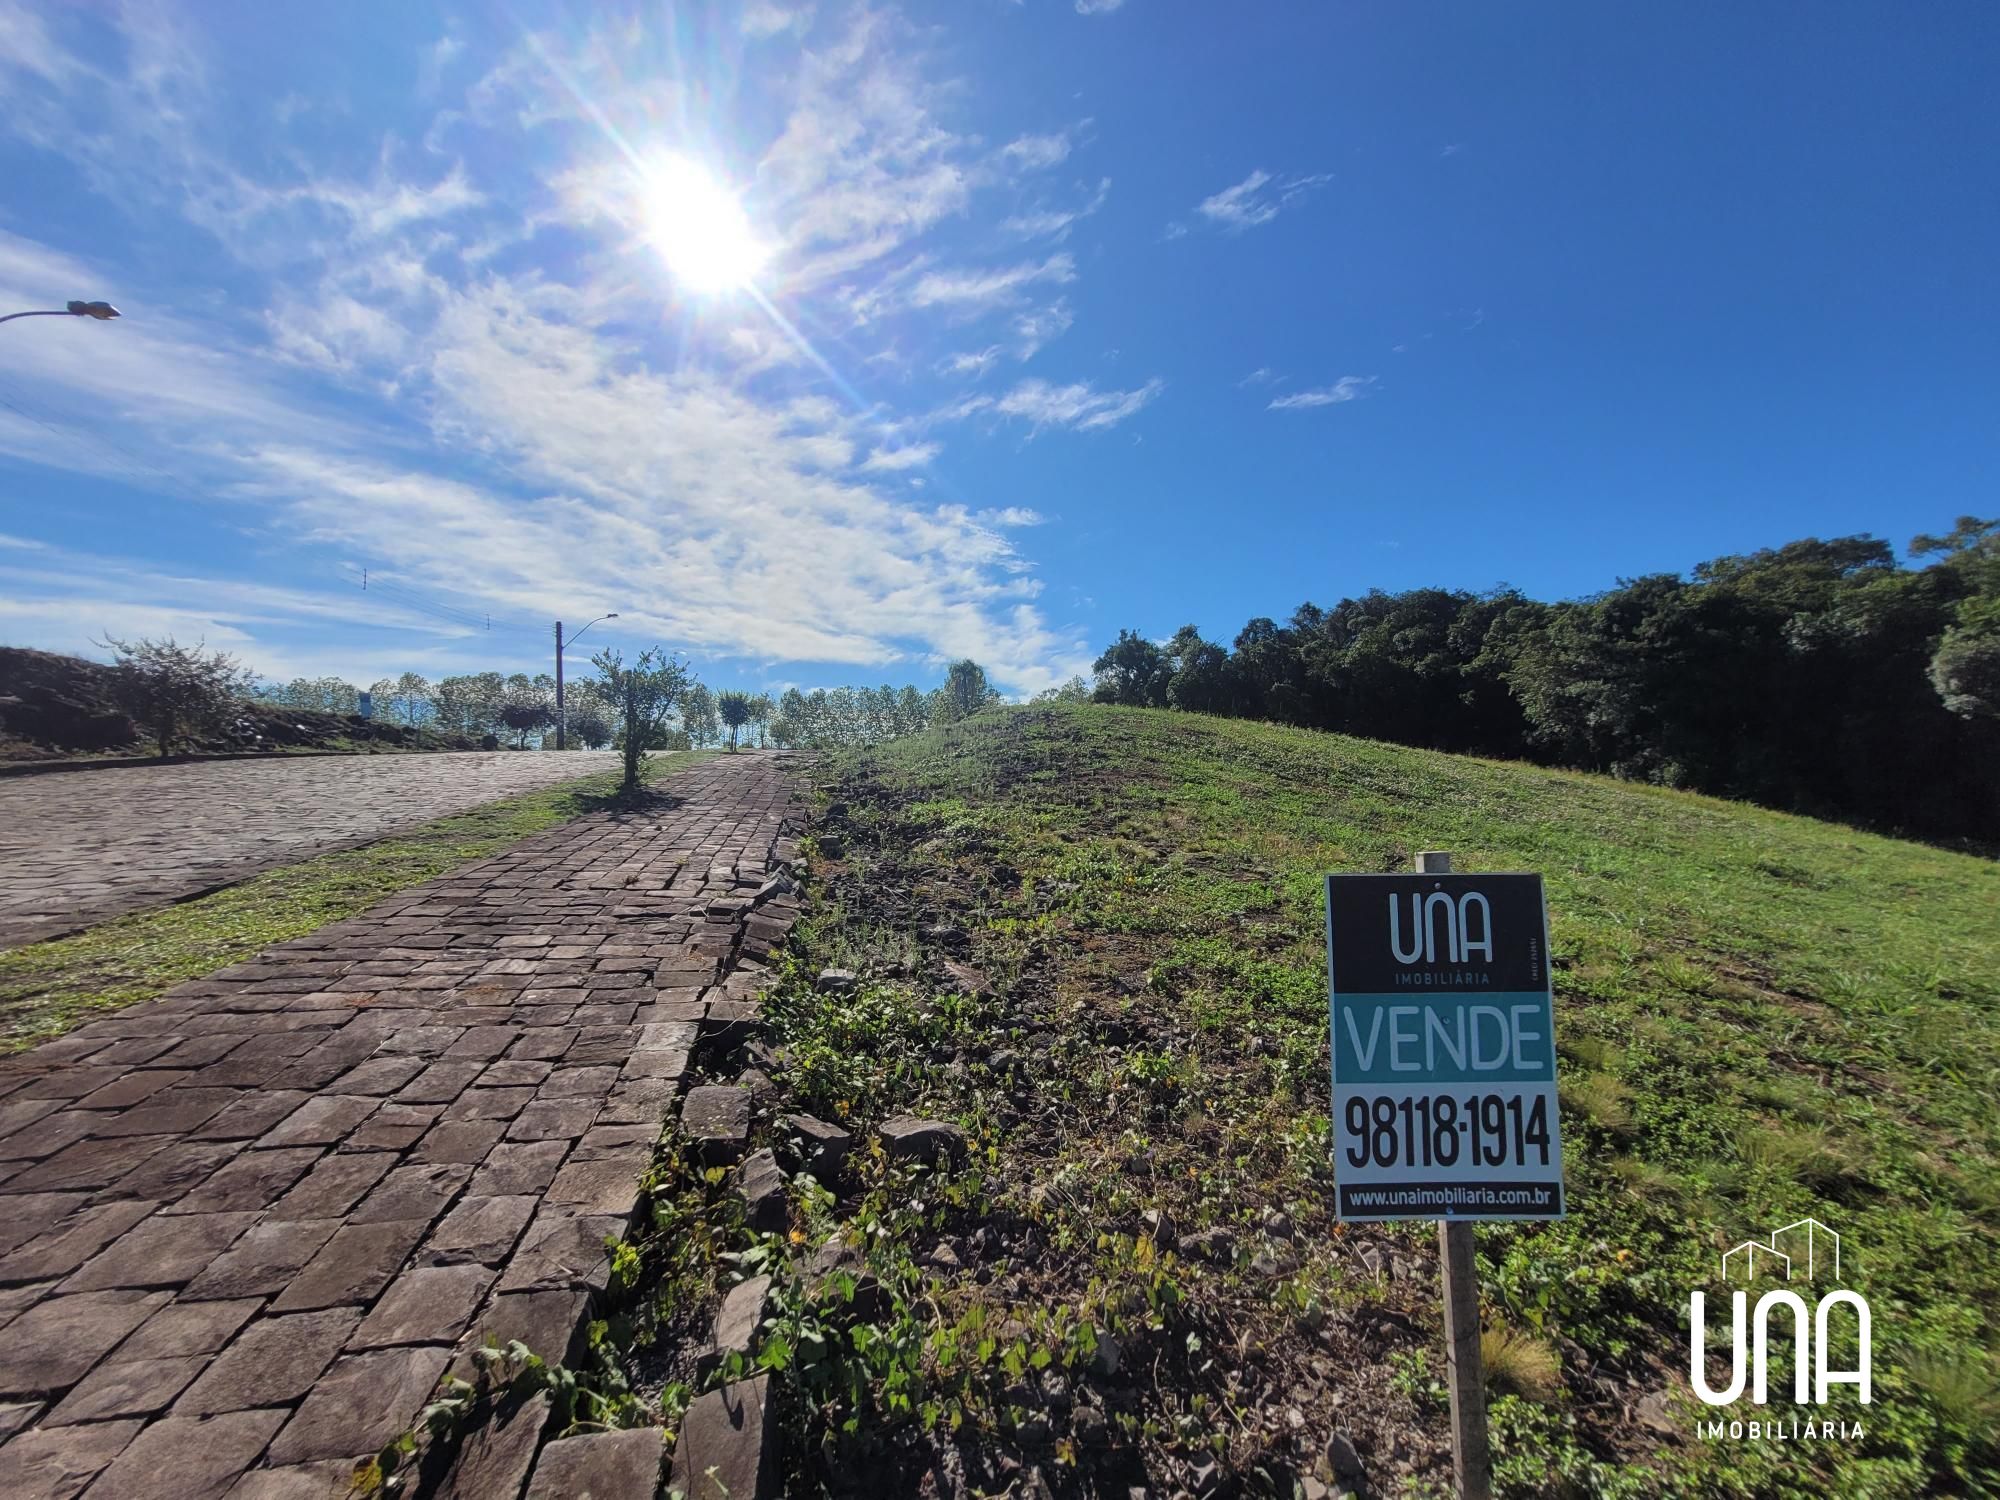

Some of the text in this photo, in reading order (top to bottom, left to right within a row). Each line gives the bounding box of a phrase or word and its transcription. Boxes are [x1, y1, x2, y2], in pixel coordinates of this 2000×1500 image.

[1389, 892, 1493, 964] UNA
[1395, 970, 1490, 985] IMOBILIÁRIA
[1343, 1004, 1544, 1072] VENDE
[1350, 1187, 1551, 1206] www.unaimobiliaria.com.br
